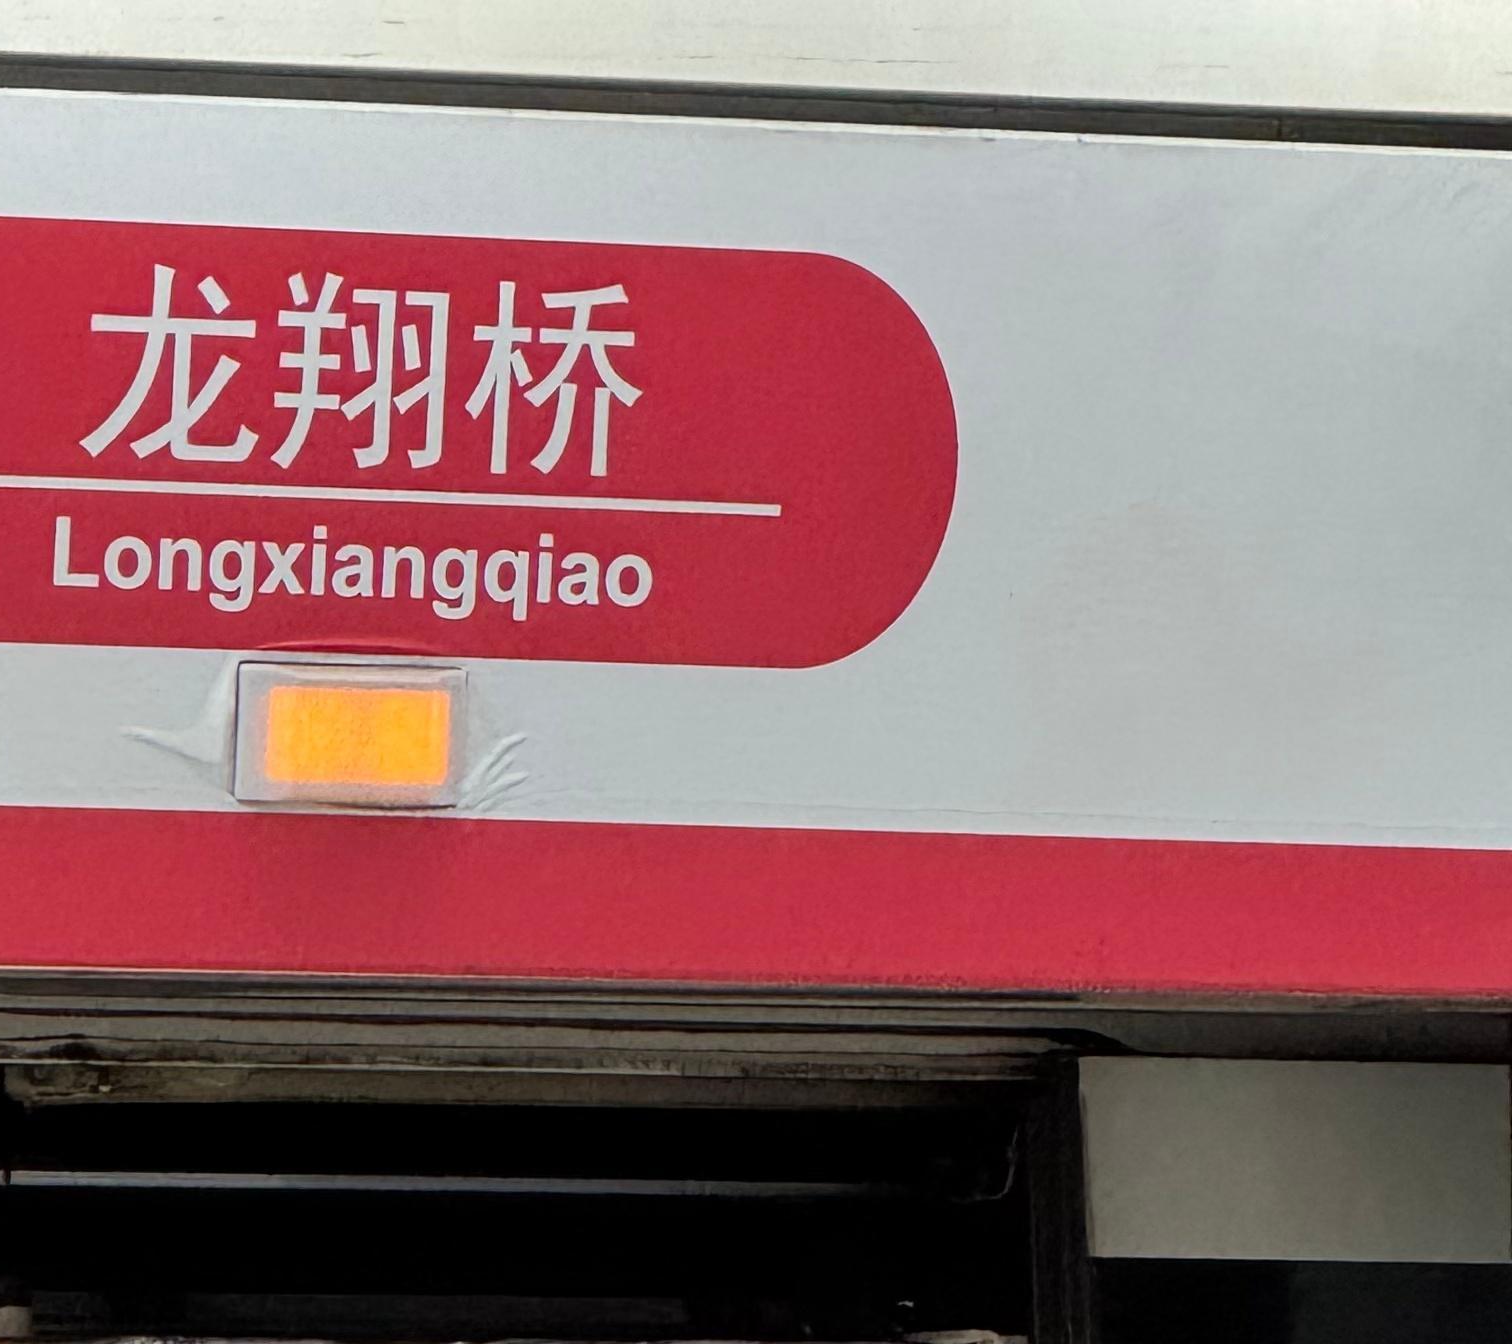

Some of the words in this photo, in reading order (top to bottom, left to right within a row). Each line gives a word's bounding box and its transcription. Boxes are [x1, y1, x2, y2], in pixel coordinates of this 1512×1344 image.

[80, 263, 644, 477] 龙翔桥
[53, 515, 654, 622] Longxiangqiao
